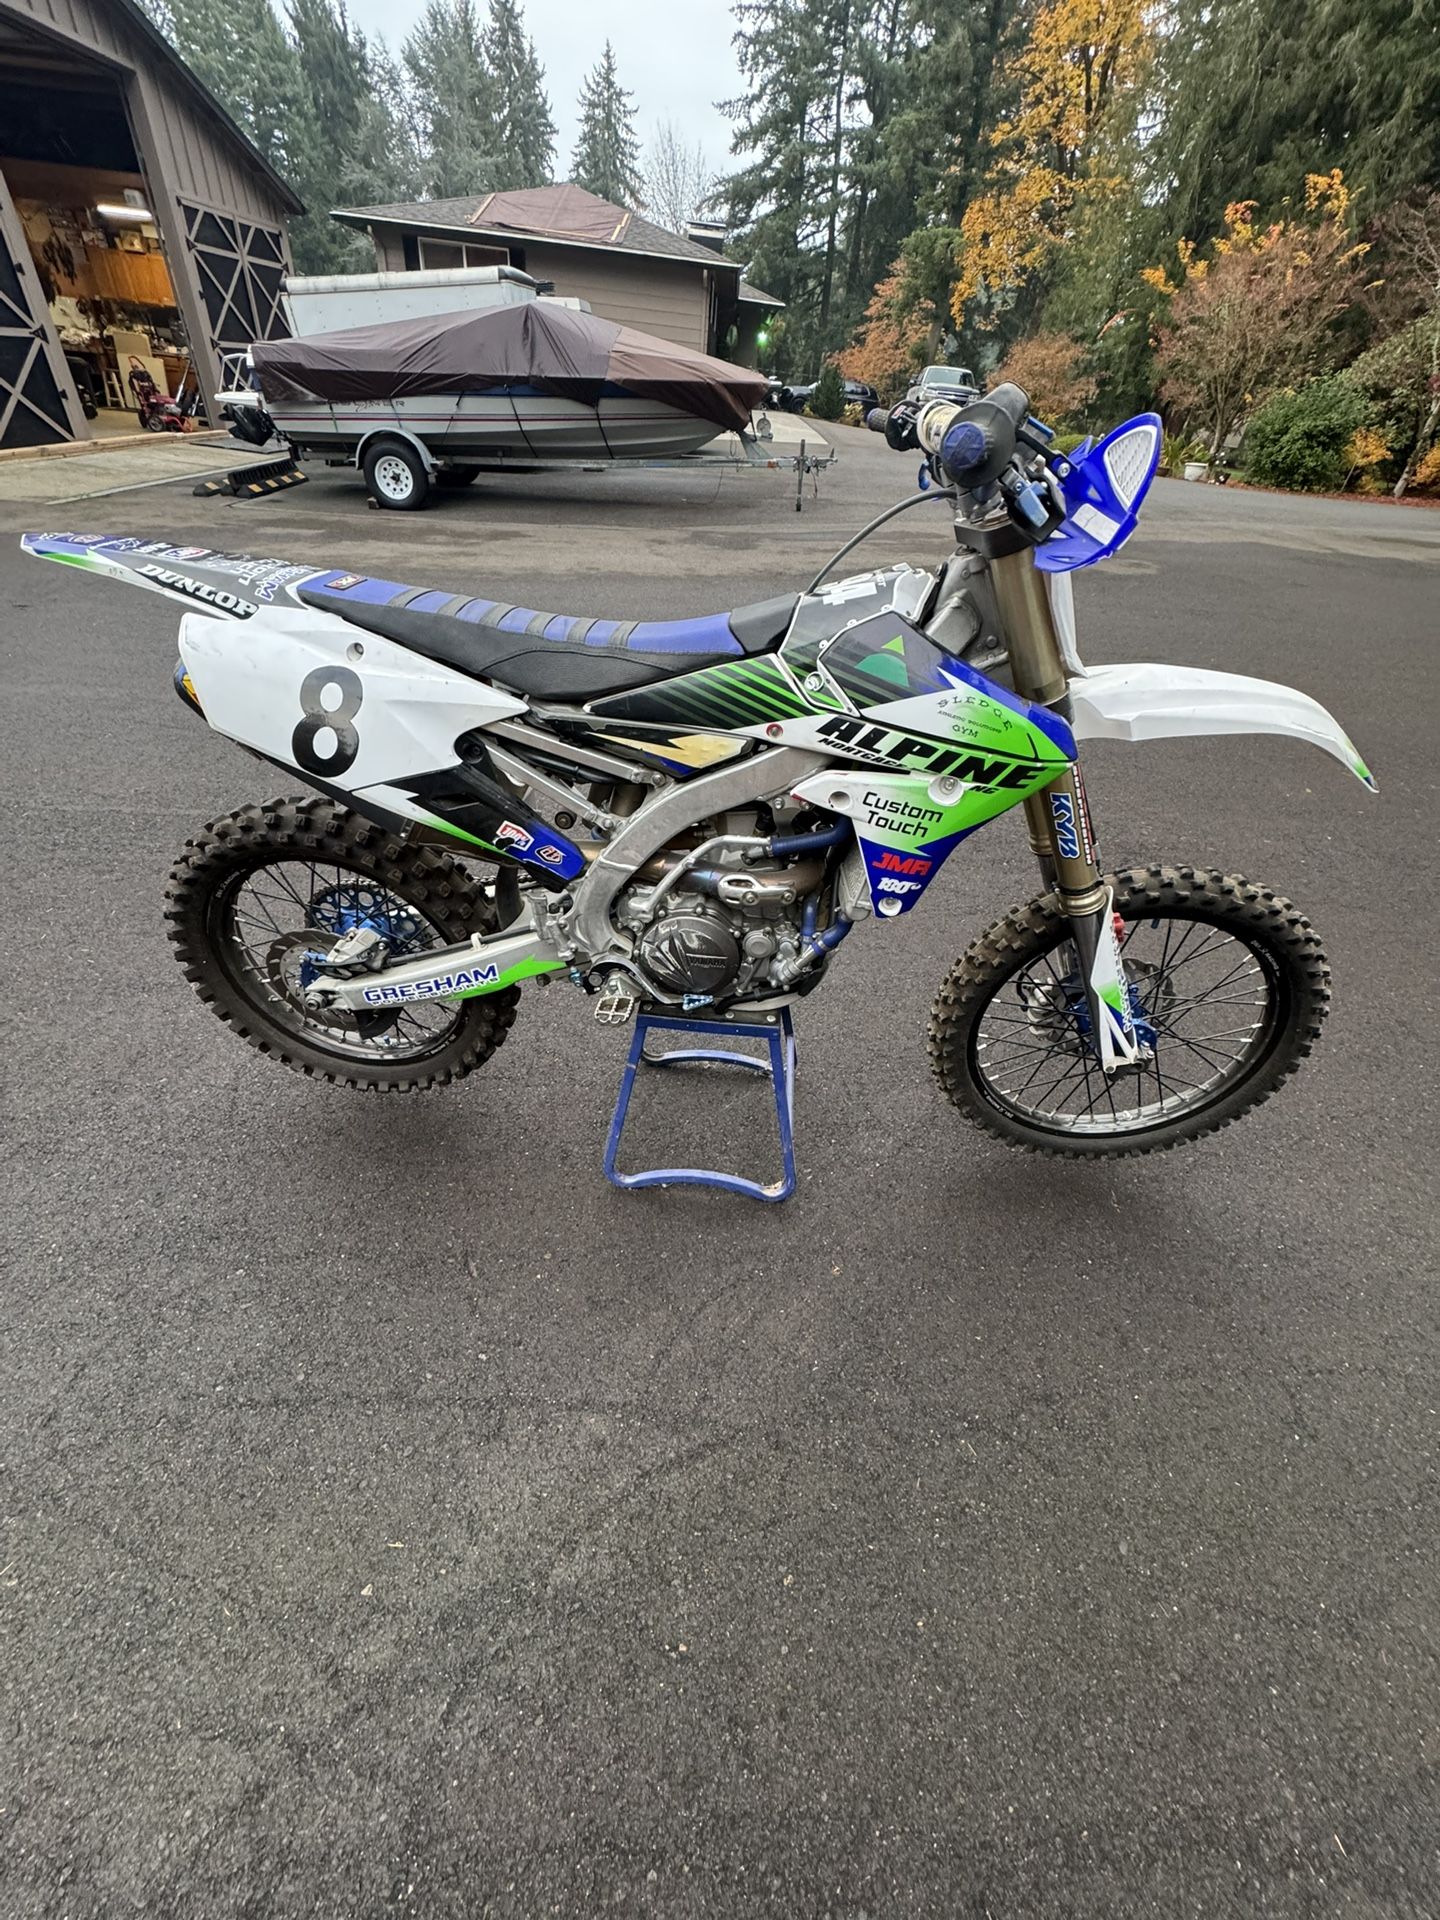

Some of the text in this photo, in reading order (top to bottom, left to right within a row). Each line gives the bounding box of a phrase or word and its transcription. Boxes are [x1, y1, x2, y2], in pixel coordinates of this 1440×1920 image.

[135, 564, 258, 615] DUNLOP
[292, 665, 363, 778] 8
[952, 724, 979, 738] GYM
[816, 715, 1048, 789] ALPINE
[862, 791, 944, 823] Custom
[867, 810, 929, 838] Touch
[1050, 792, 1080, 858] KYB
[686, 957, 727, 969] YAMAHA
[363, 963, 498, 1003] GRESHAM
[370, 976, 500, 1006] POWERSPORTS
